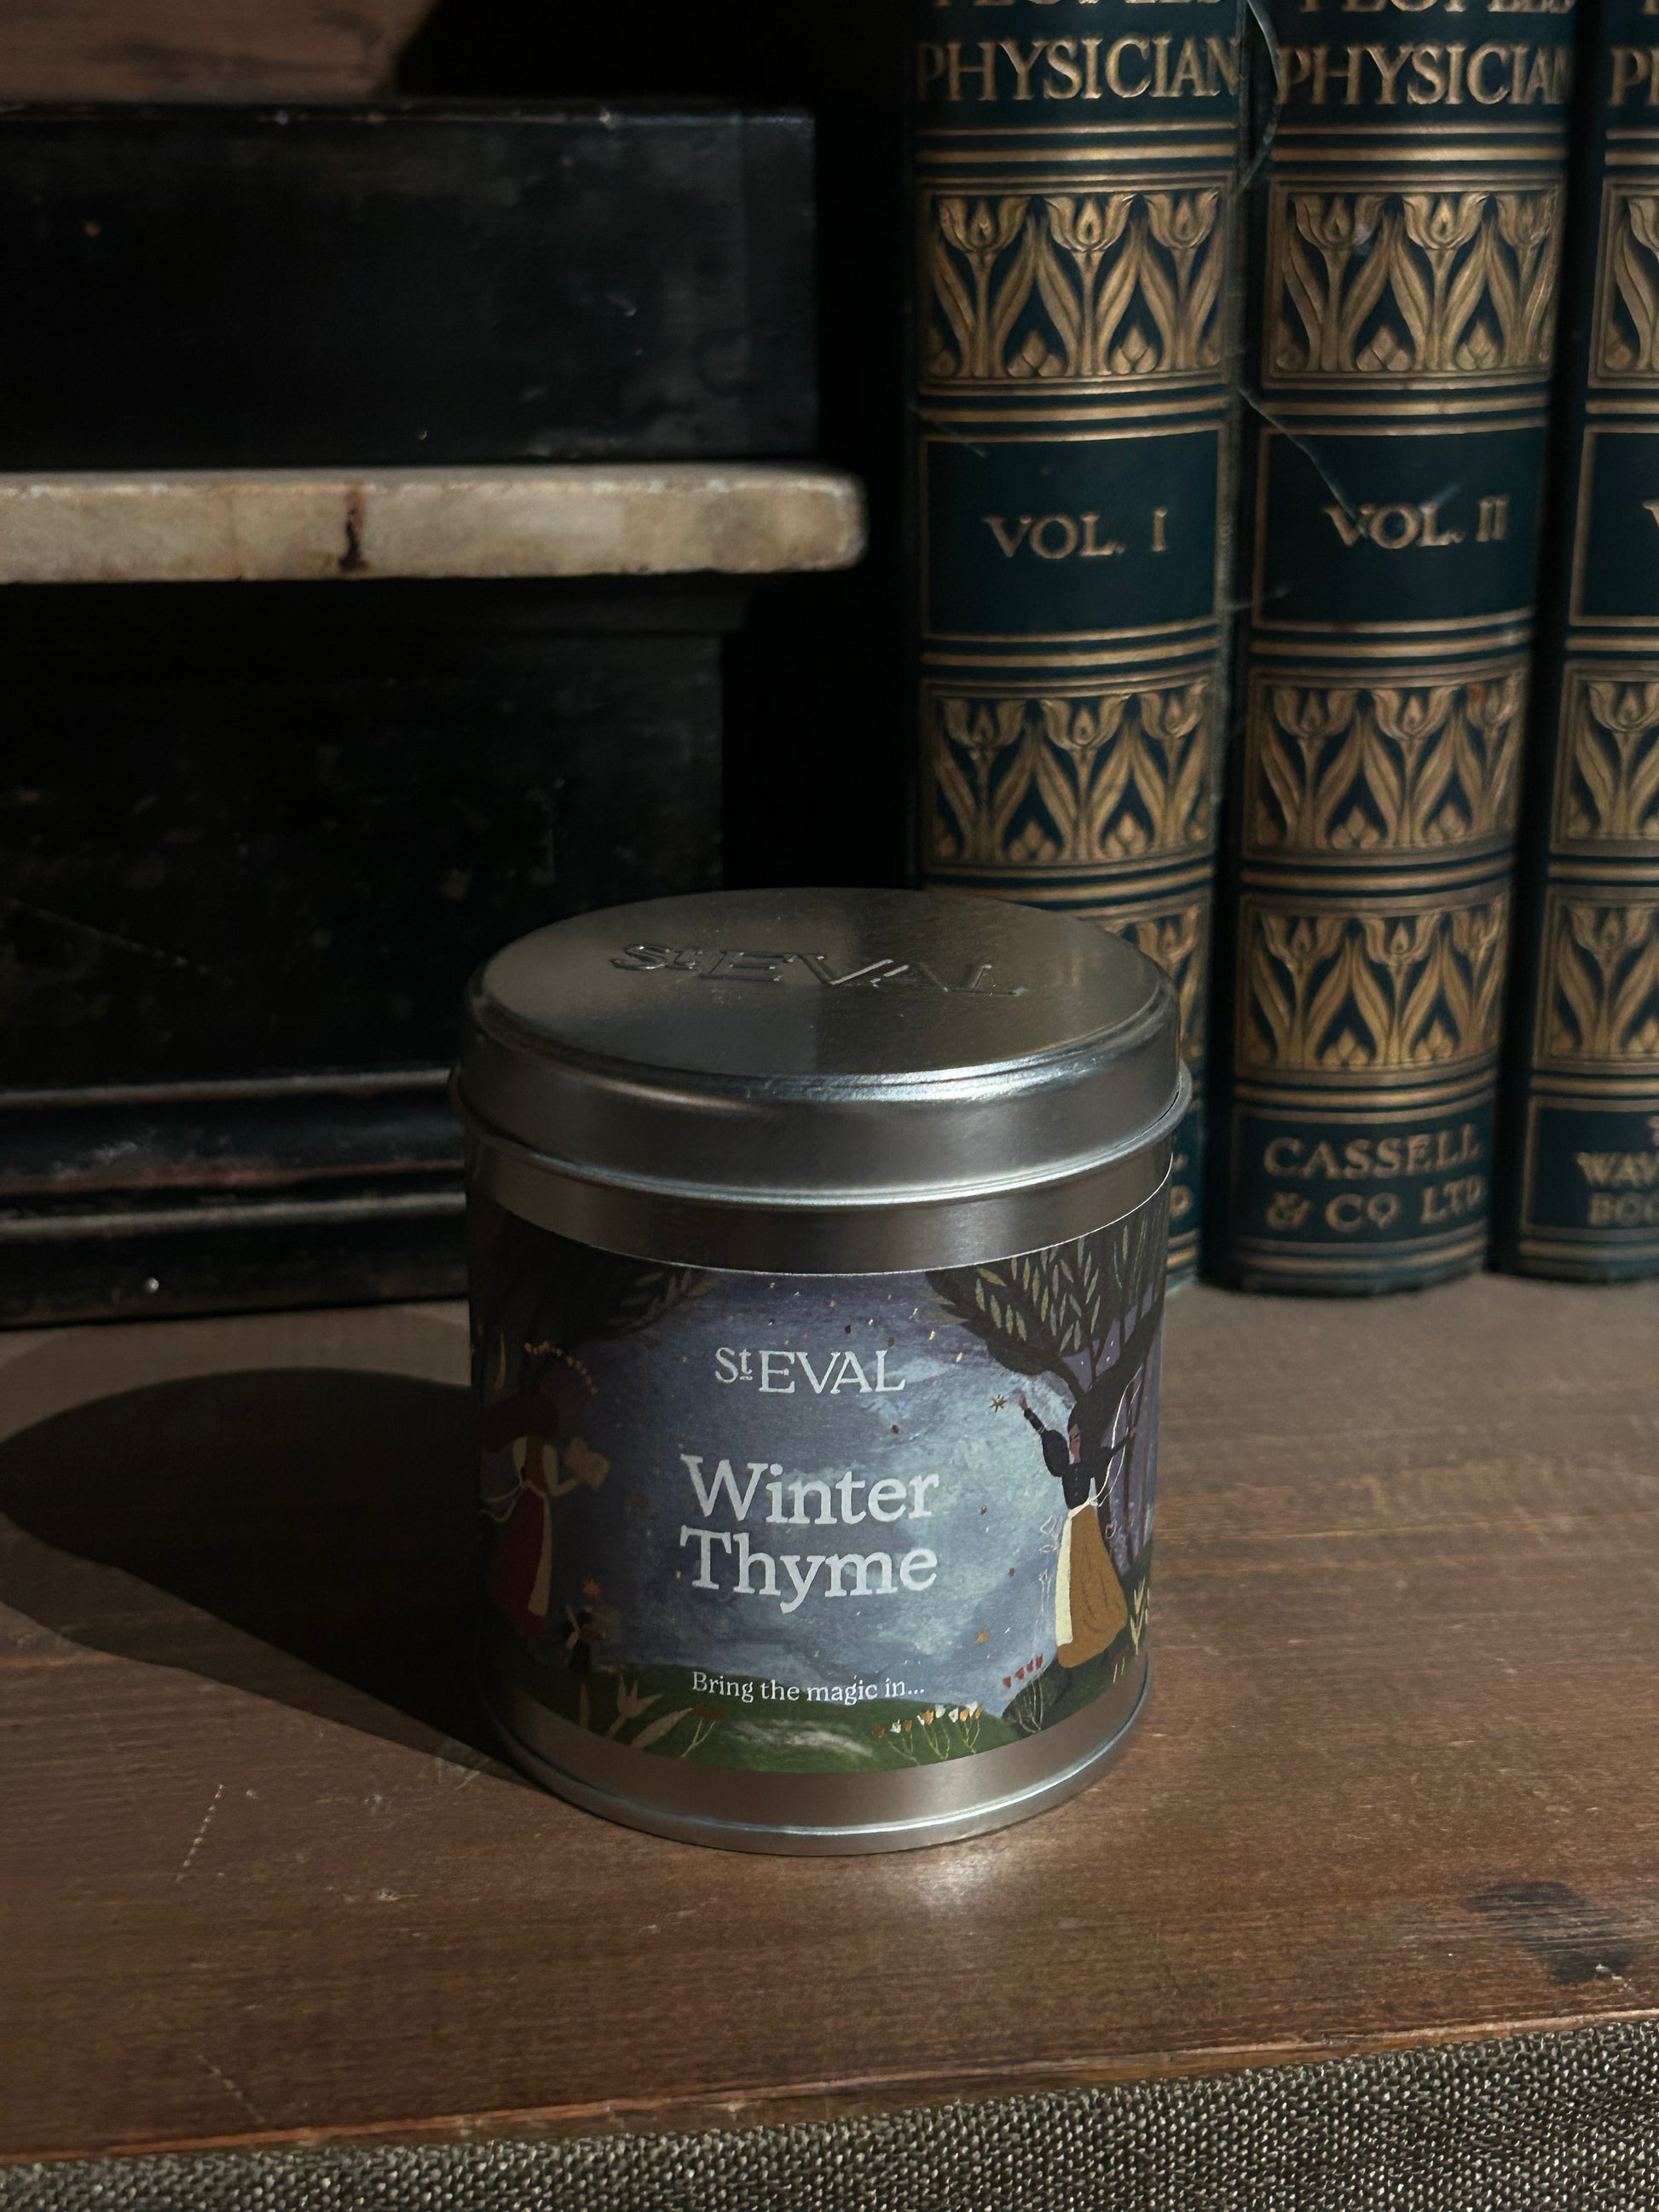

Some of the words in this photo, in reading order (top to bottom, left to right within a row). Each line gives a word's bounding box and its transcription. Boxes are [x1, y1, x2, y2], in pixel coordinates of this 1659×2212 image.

[916, 36, 1240, 101] PHYSICIAN
[1275, 43, 1575, 105] PHYSICIAN
[1152, 506, 1168, 552] I
[1476, 494, 1511, 543] II
[1263, 1123, 1484, 1181] CASSELL
[1266, 1192, 1313, 1232] &
[680, 1453, 939, 1525] Winter
[679, 1525, 938, 1614] Thyme
[692, 1671, 754, 1703] Bring
[760, 1679, 800, 1701] the
[806, 1678, 878, 1706] magic
